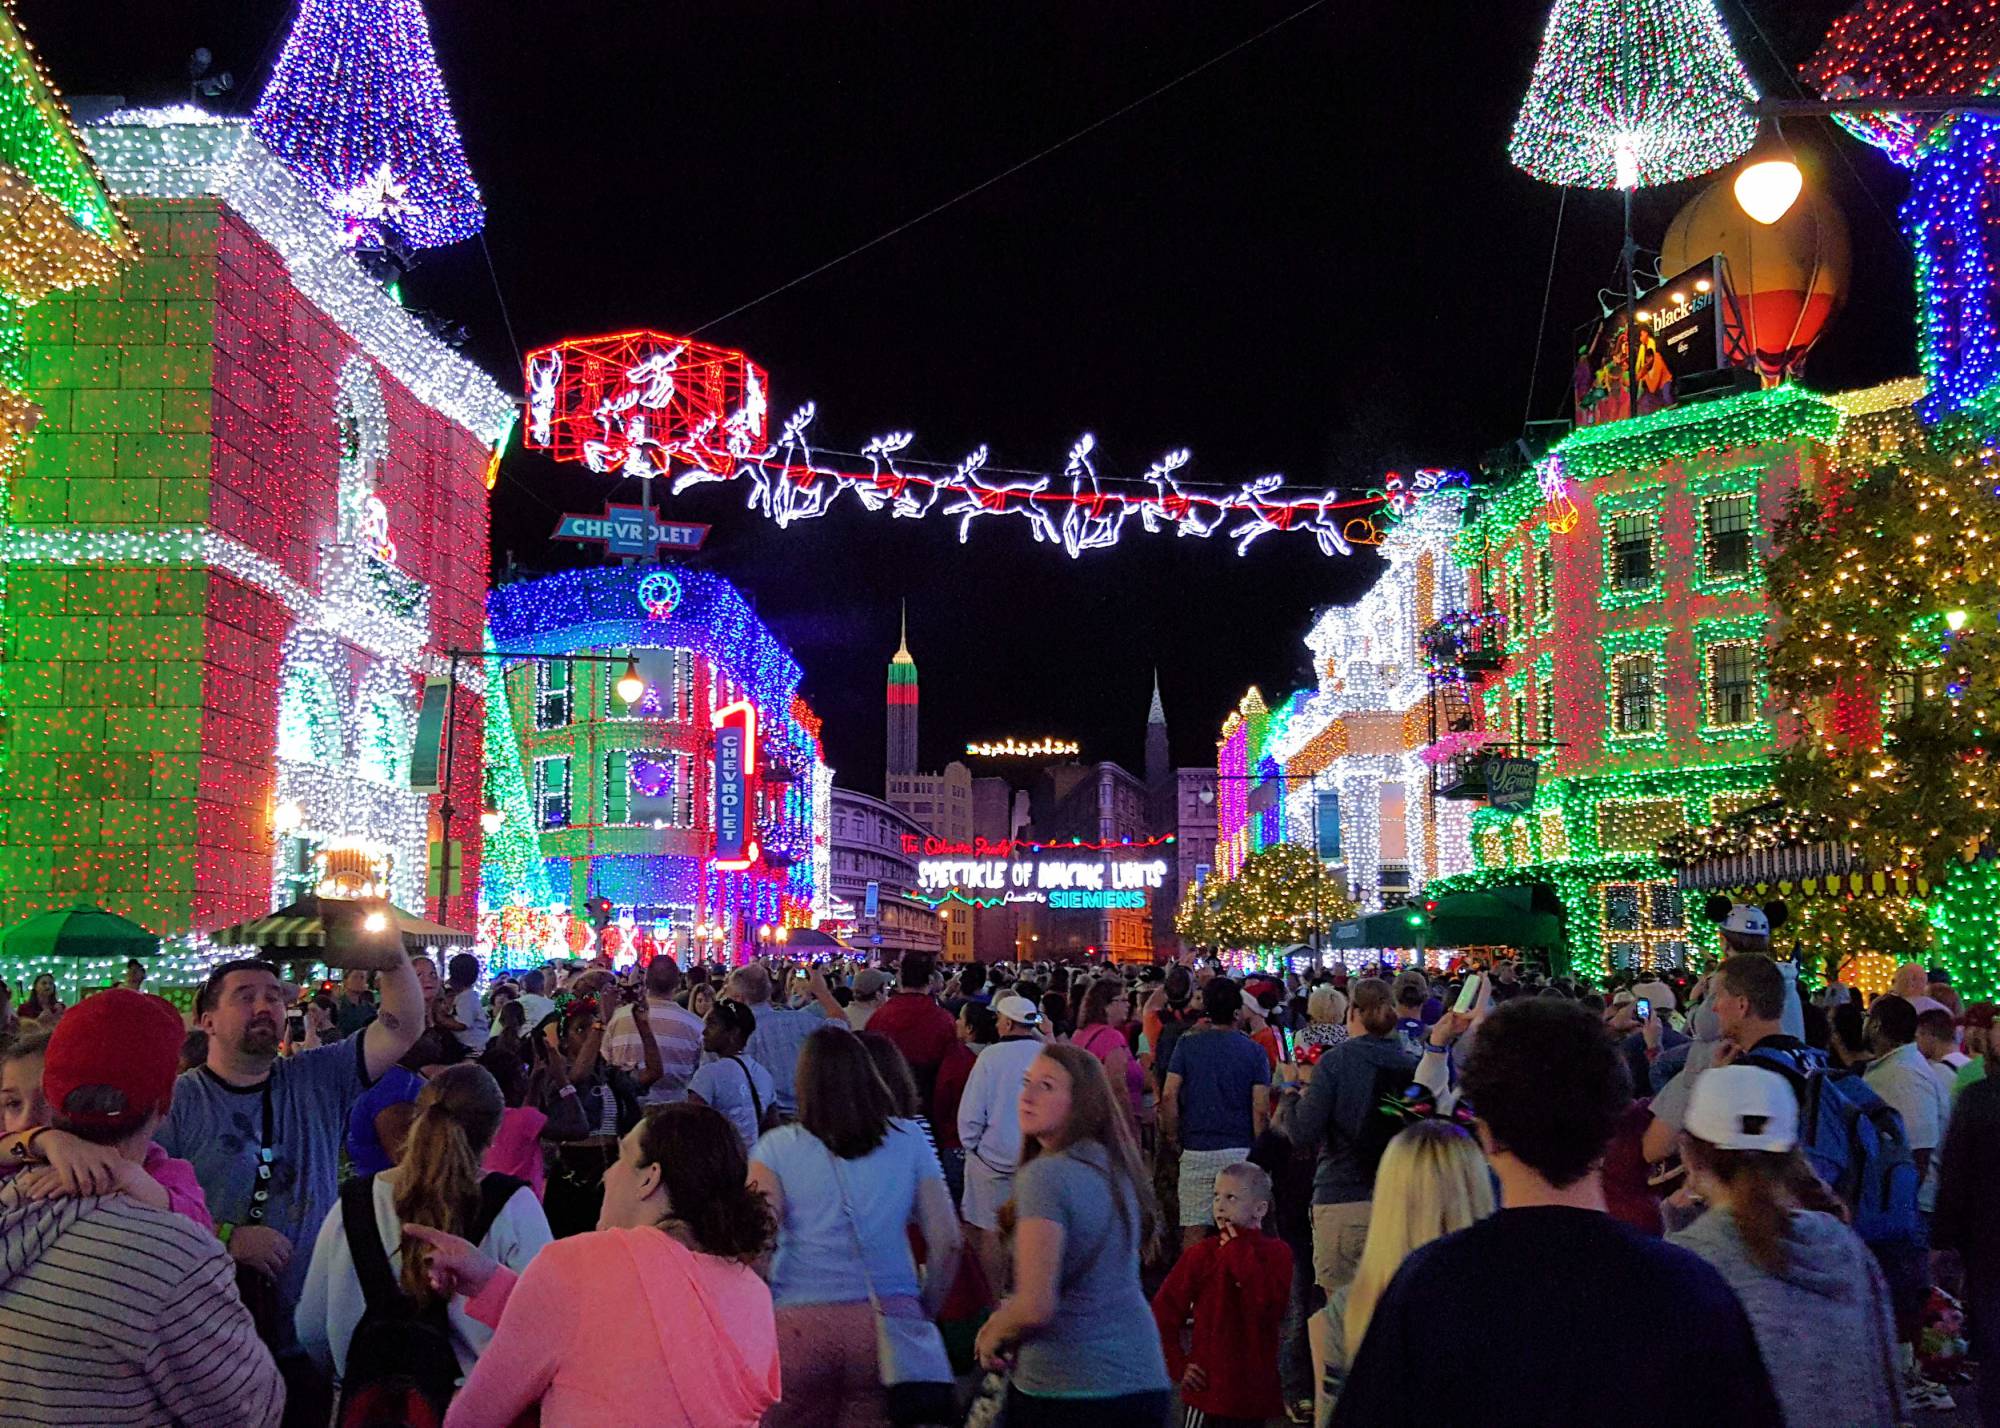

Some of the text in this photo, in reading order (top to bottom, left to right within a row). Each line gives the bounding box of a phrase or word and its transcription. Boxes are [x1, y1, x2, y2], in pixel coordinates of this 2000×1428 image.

[571, 519, 693, 544] CHEVROLET
[721, 736, 739, 841] CHEVROLET
[1012, 861, 1033, 888] OF
[1048, 890, 1146, 909] SIEMENS
